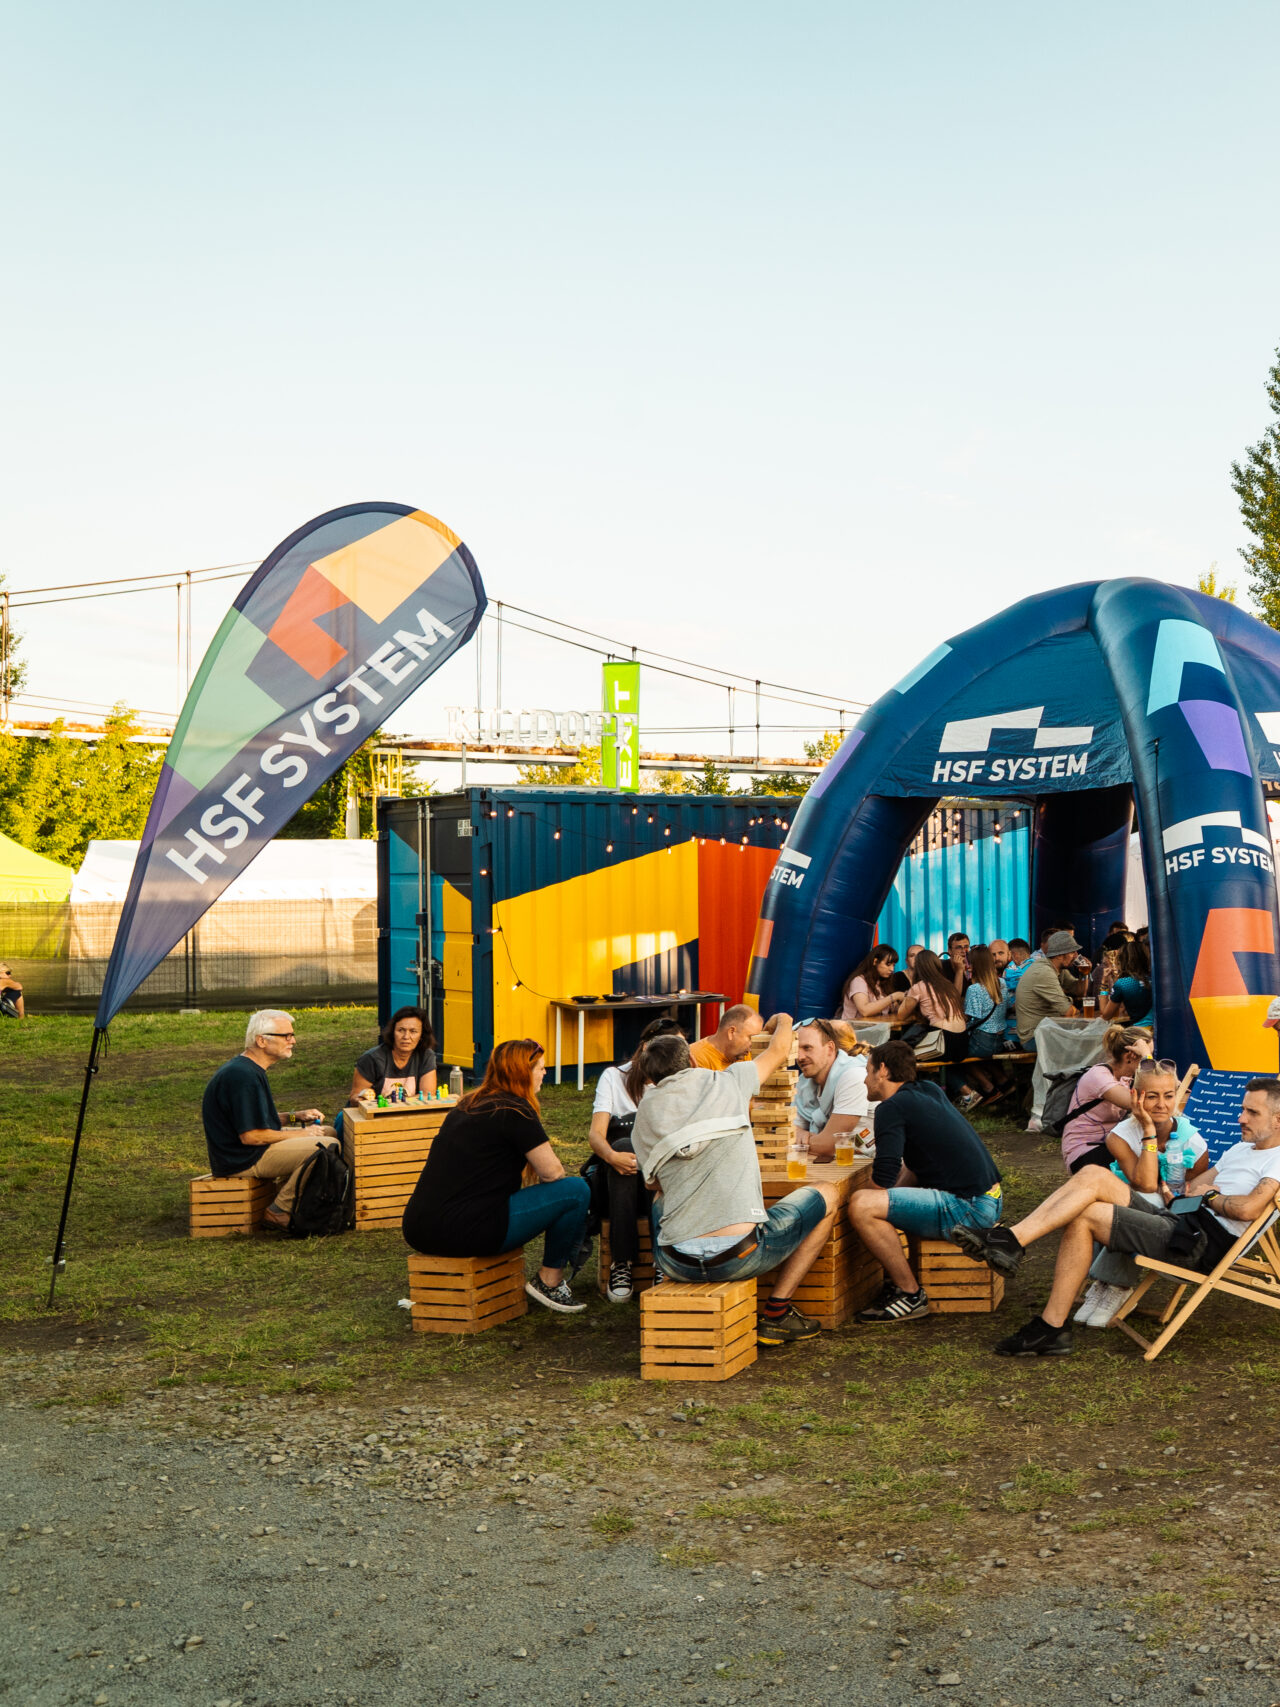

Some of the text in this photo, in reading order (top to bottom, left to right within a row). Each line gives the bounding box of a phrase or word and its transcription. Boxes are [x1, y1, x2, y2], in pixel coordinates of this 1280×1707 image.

[166, 607, 455, 885] HSF SYSTEM
[932, 752, 1089, 783] HSF SYSTEM
[1165, 848, 1205, 876] HSF
